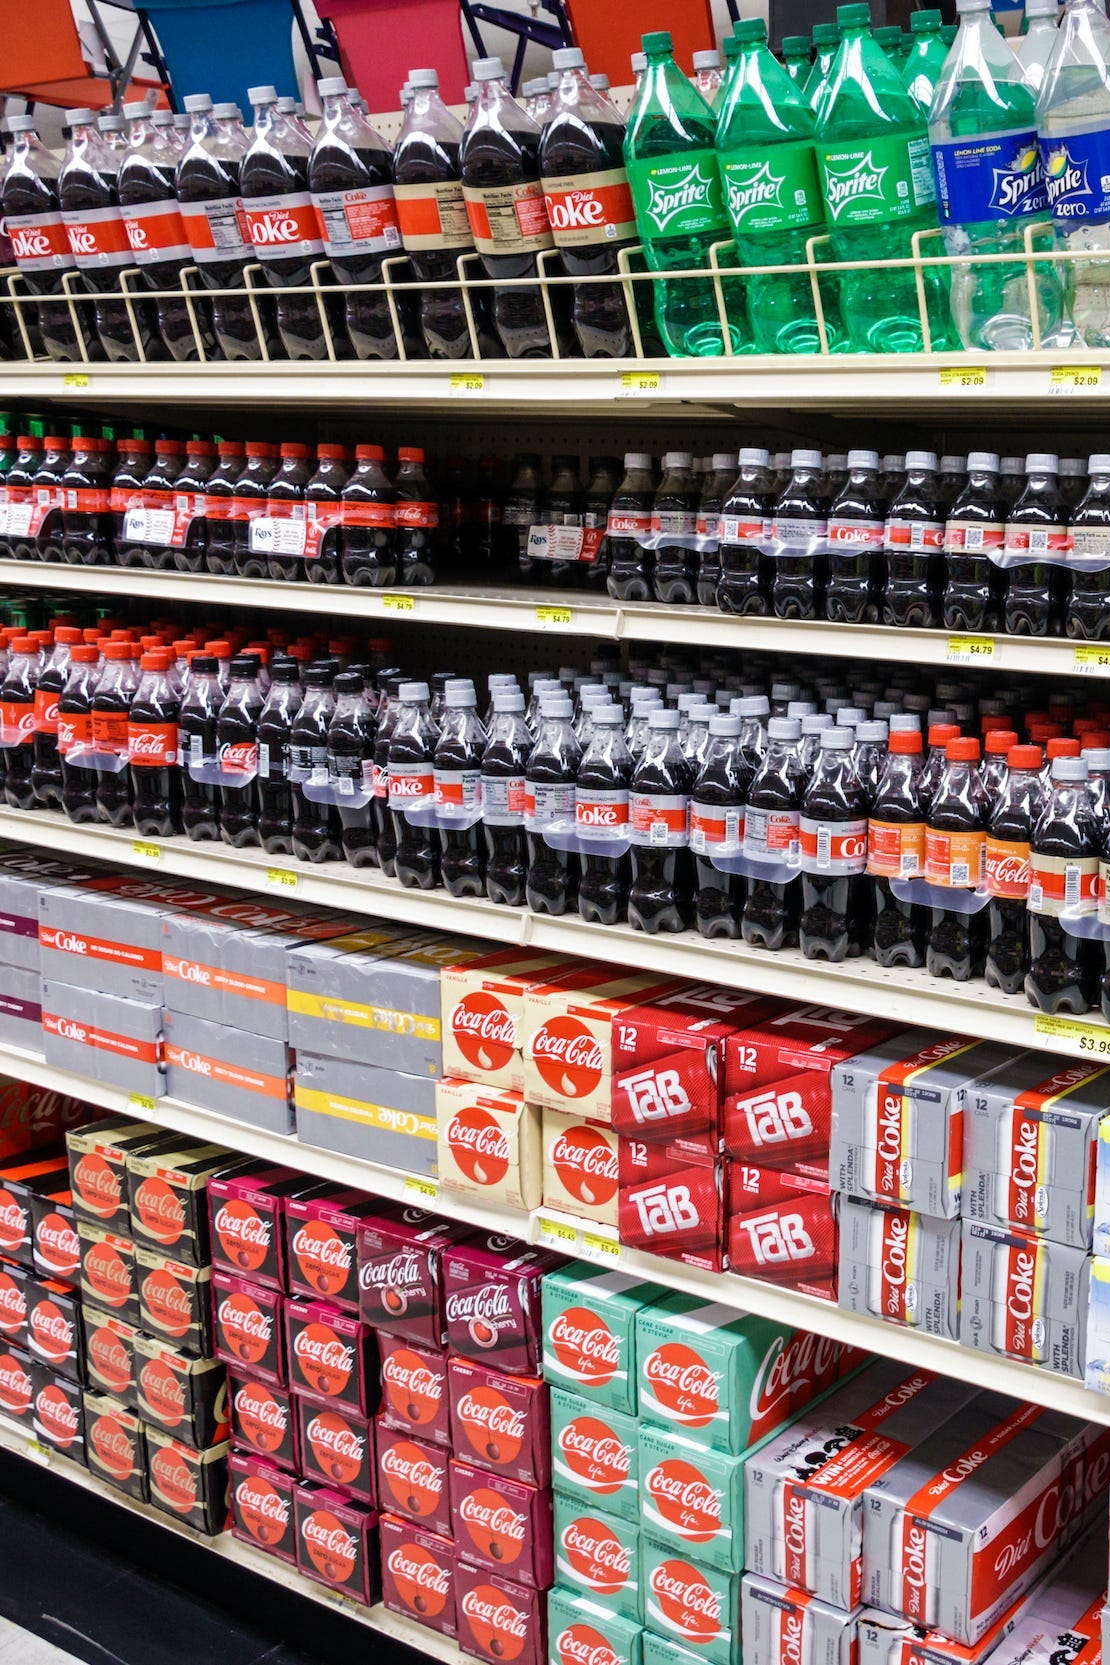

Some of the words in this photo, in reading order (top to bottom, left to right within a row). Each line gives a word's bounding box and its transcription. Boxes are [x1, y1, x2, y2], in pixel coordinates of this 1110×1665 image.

[730, 181, 775, 211] Sprite
[828, 172, 878, 202] Sprite
[653, 184, 705, 214] Sprite
[961, 377, 984, 386] $2.09
[1074, 377, 1098, 386] $2.09
[611, 518, 639, 530] Coke
[838, 528, 869, 543] Coke
[970, 645, 993, 656] $4.79
[446, 975, 468, 984] VANILLA
[619, 1026, 637, 1045] 12
[620, 1043, 636, 1052] cans
[738, 1046, 757, 1066] 12
[740, 1064, 757, 1073] cans
[877, 1096, 901, 1162] Coke
[629, 1142, 648, 1160] 12
[1012, 1122, 1038, 1188] Coke
[632, 1157, 647, 1167] cans
[741, 1167, 760, 1187] 12
[882, 1163, 894, 1191] Diet
[1016, 1191, 1029, 1219] Diet
[934, 1290, 942, 1339] SPLENDA
[490, 1318, 516, 1331] cherry
[638, 1320, 655, 1329] CANE
[1062, 1325, 1070, 1372] SPLENDA
[812, 1470, 836, 1487] WIN
[903, 1527, 926, 1586] Coke
